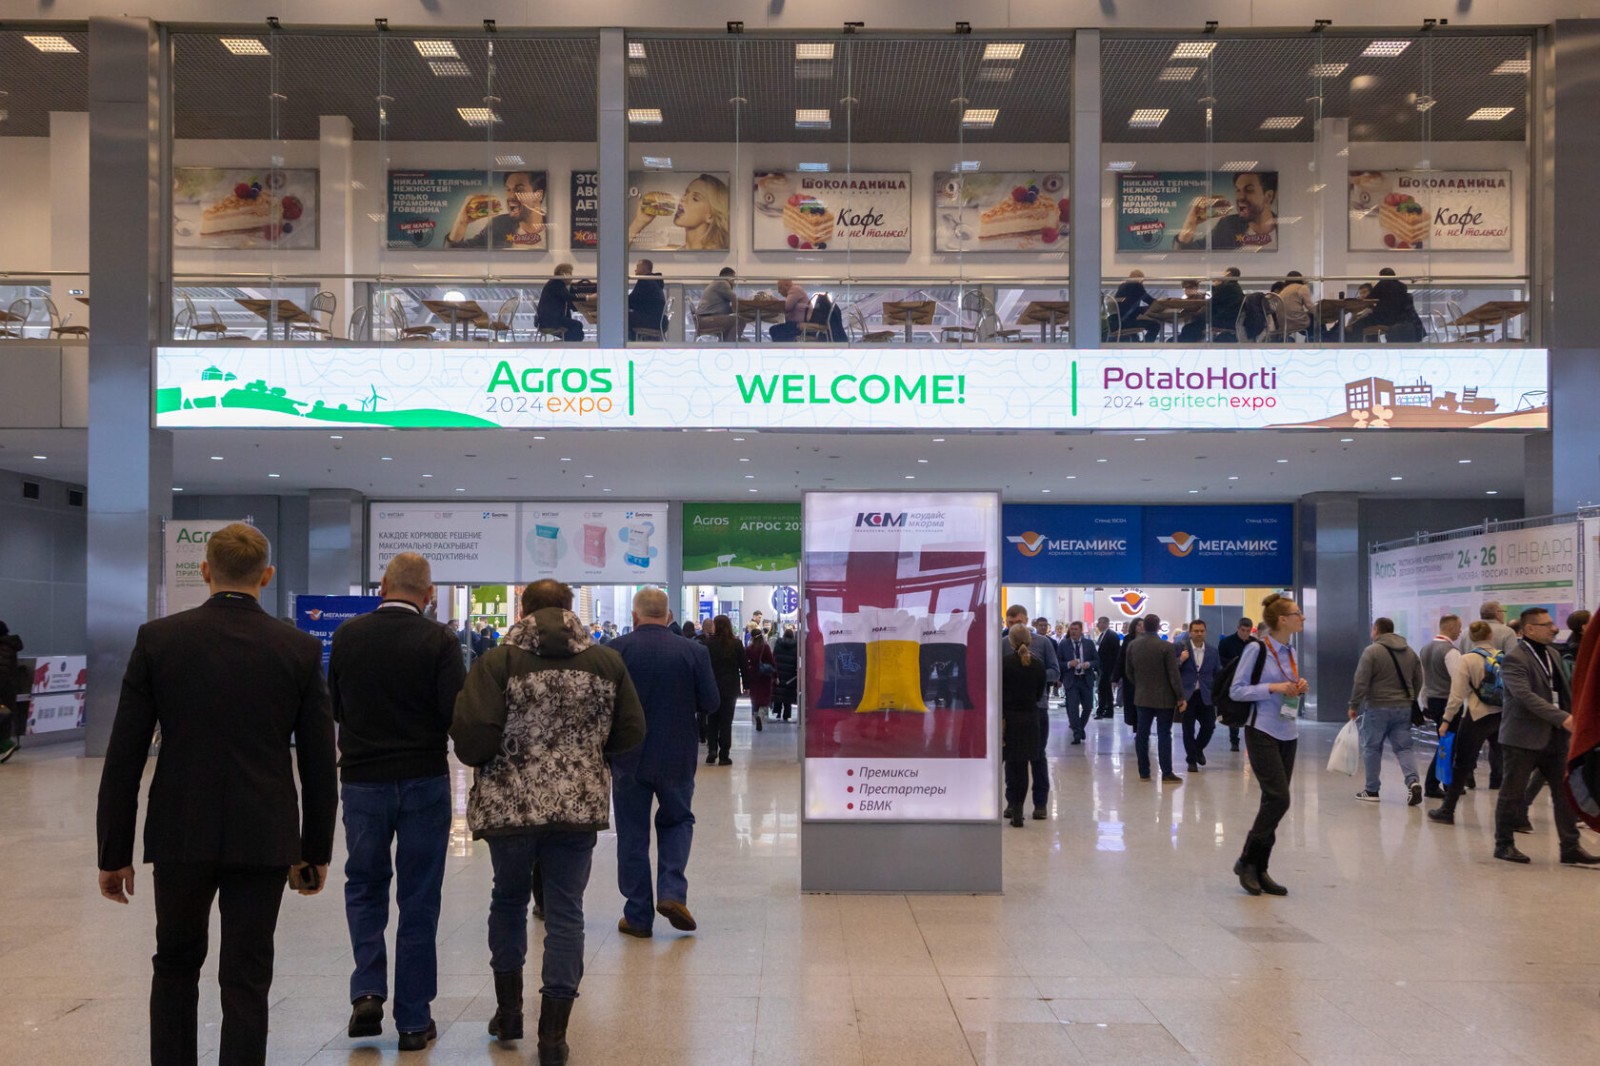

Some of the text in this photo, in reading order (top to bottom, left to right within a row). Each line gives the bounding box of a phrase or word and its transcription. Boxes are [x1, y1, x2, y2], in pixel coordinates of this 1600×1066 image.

[802, 178, 906, 190] ШОКОЛАДНИЦА
[1399, 177, 1506, 188] ШОКОЛАДНИЦА
[393, 206, 440, 214] ГОВЯДИНА
[1123, 207, 1169, 215] ГОВЯДИНА
[837, 207, 884, 235] Кофе
[1434, 206, 1483, 234] Кофе
[850, 229, 862, 238] не
[866, 227, 908, 238] только!
[1448, 228, 1460, 236] не
[1464, 226, 1508, 237] только!
[487, 360, 613, 394] Agros
[1103, 366, 1278, 390] PotatoHorti
[735, 374, 966, 405] WELCOME!
[486, 396, 613, 417] 2024 expo
[1103, 396, 1144, 409] 2024
[693, 514, 730, 526] Agros
[740, 522, 802, 531] АГРОС 20
[378, 531, 482, 540] КАЖДОЕ КОРМОВОЕ РЕШЕНИЕ
[378, 542, 478, 550] МАКСИМАЛЬНО РАСКРЫВАЕТ
[1048, 540, 1127, 551] МЕГАМИКС
[1199, 540, 1278, 551] МЕГАМИКС
[1457, 549, 1471, 569] 24
[1480, 545, 1497, 567] 26
[1507, 538, 1573, 564] ЯНВАРЯ
[1514, 565, 1544, 576] КРОКУС
[1546, 563, 1574, 574] ЭКСПО
[859, 766, 919, 780] Премиксы
[859, 783, 947, 797] Престартеры
[859, 800, 893, 811] БВМК
